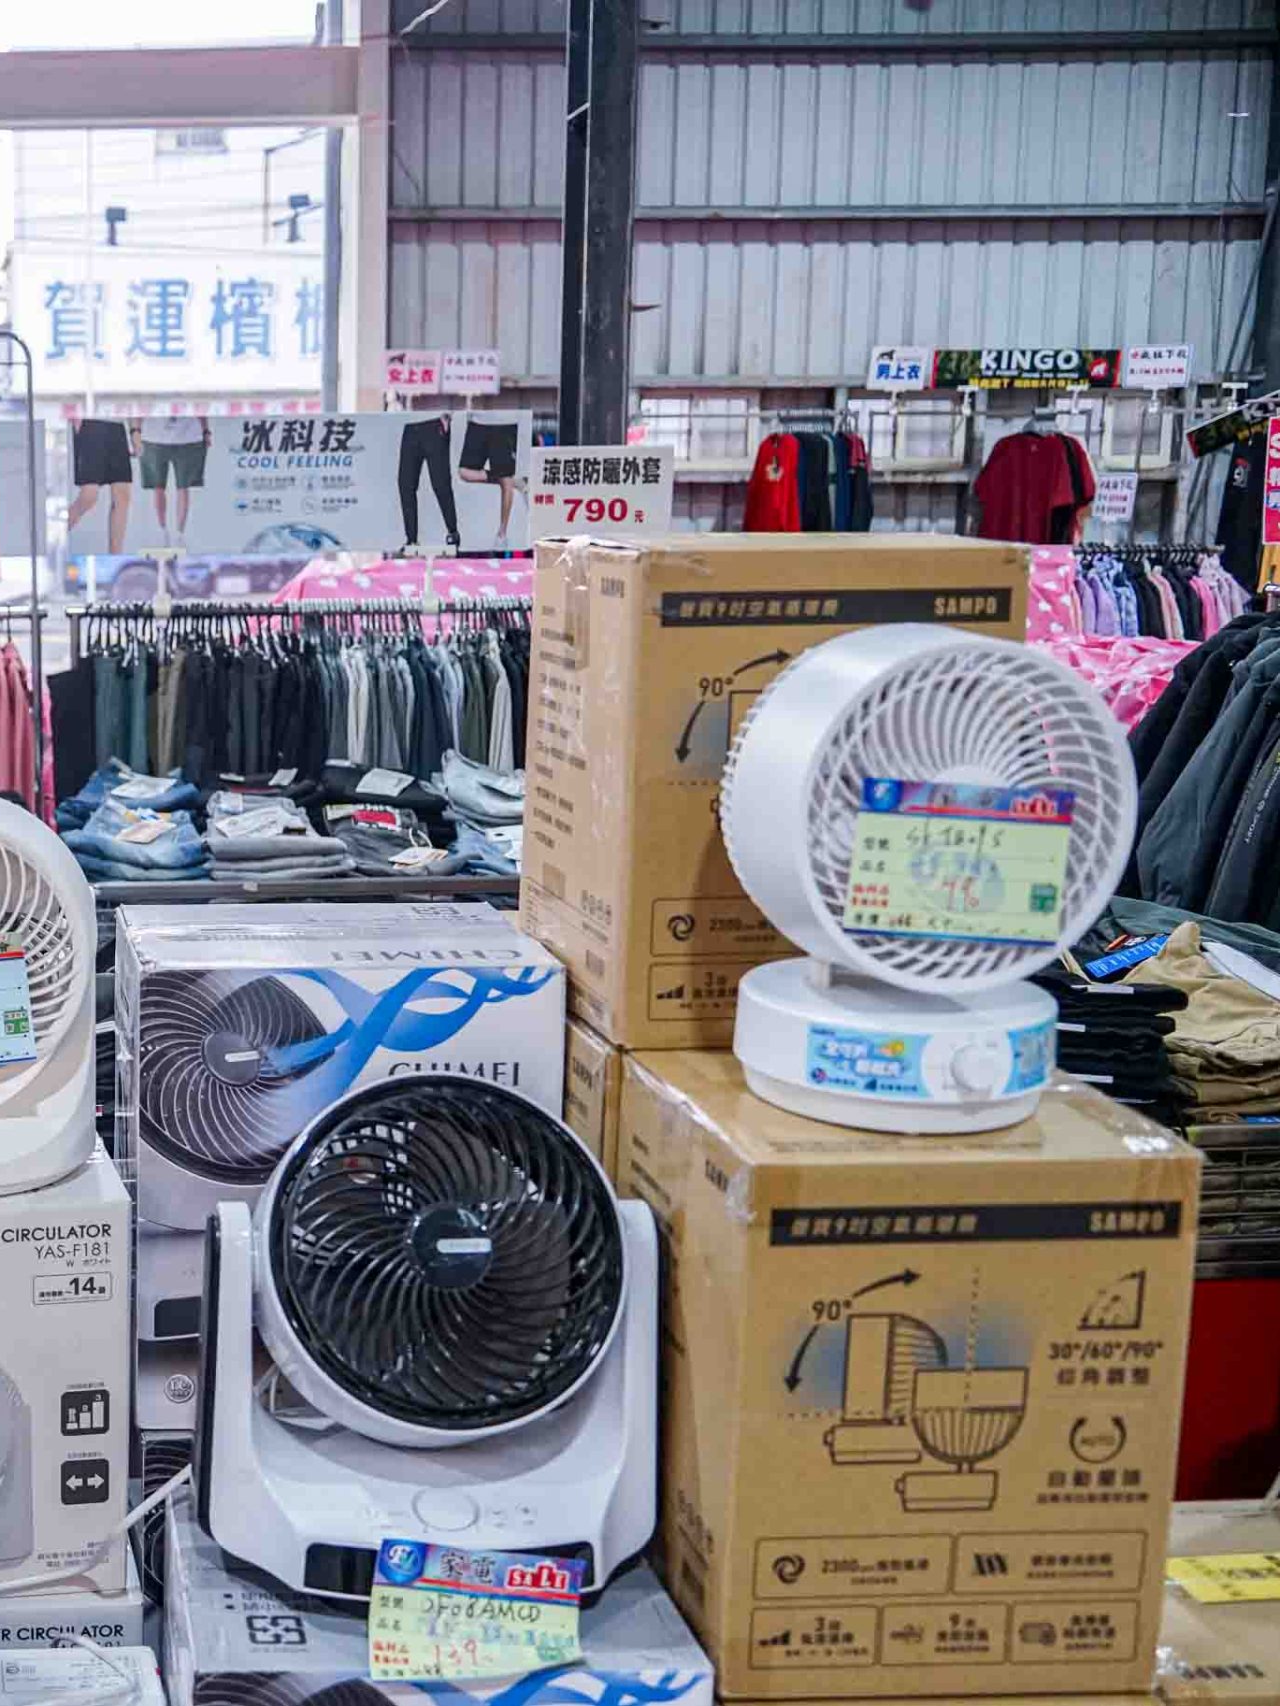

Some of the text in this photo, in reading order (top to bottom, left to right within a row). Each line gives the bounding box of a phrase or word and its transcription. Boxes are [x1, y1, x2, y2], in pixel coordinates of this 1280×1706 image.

[981, 350, 1079, 370] KINGO
[241, 419, 357, 453] 冰科技
[238, 454, 353, 469] COOL FEELING
[542, 456, 661, 485] 涼感防曬外套
[562, 497, 628, 523] 790
[933, 596, 997, 617] SAMPO
[698, 676, 734, 697] 90°
[1088, 1210, 1166, 1234] SAMPO
[1, 1224, 112, 1243] CIRCULATOR
[34, 1241, 110, 1260] YAS-F181
[810, 1298, 853, 1322] 90°
[439, 1551, 497, 1585] 家電
